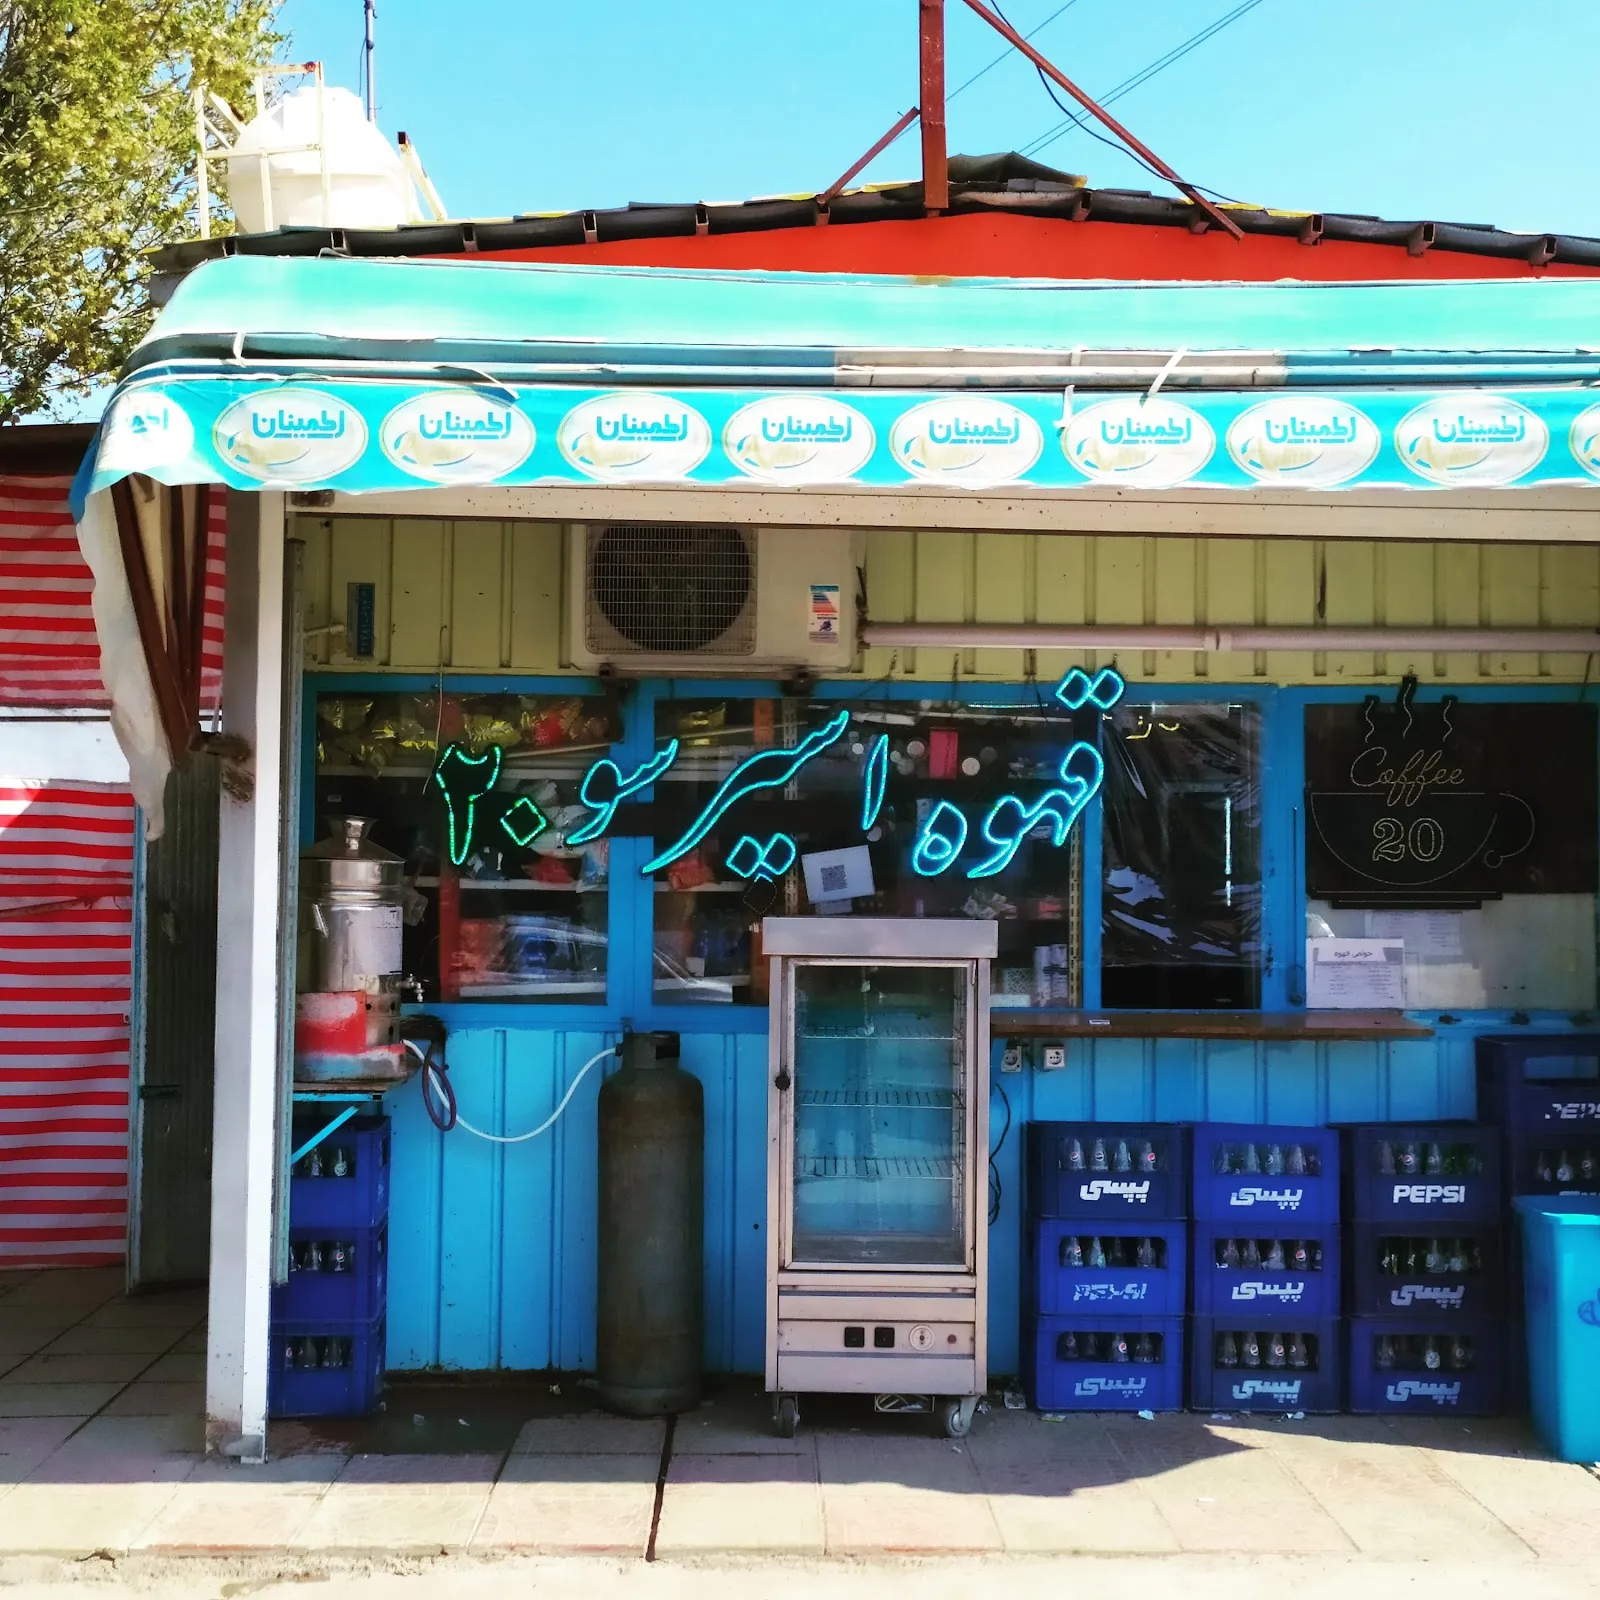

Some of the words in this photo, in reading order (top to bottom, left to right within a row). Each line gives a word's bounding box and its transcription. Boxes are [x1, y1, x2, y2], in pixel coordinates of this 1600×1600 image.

[912, 669, 1124, 878] قهوه
[1349, 747, 1464, 807] Coffee
[1372, 818, 1444, 862] 20
[1080, 1180, 1149, 1204] پپسی
[1230, 1187, 1302, 1210] پپسی
[1393, 1184, 1465, 1204] PEPSI
[1232, 1281, 1304, 1303] پپسی
[1391, 1285, 1464, 1308] پپسی
[1233, 1380, 1302, 1403] پپسی
[1387, 1380, 1460, 1404] پپسی
